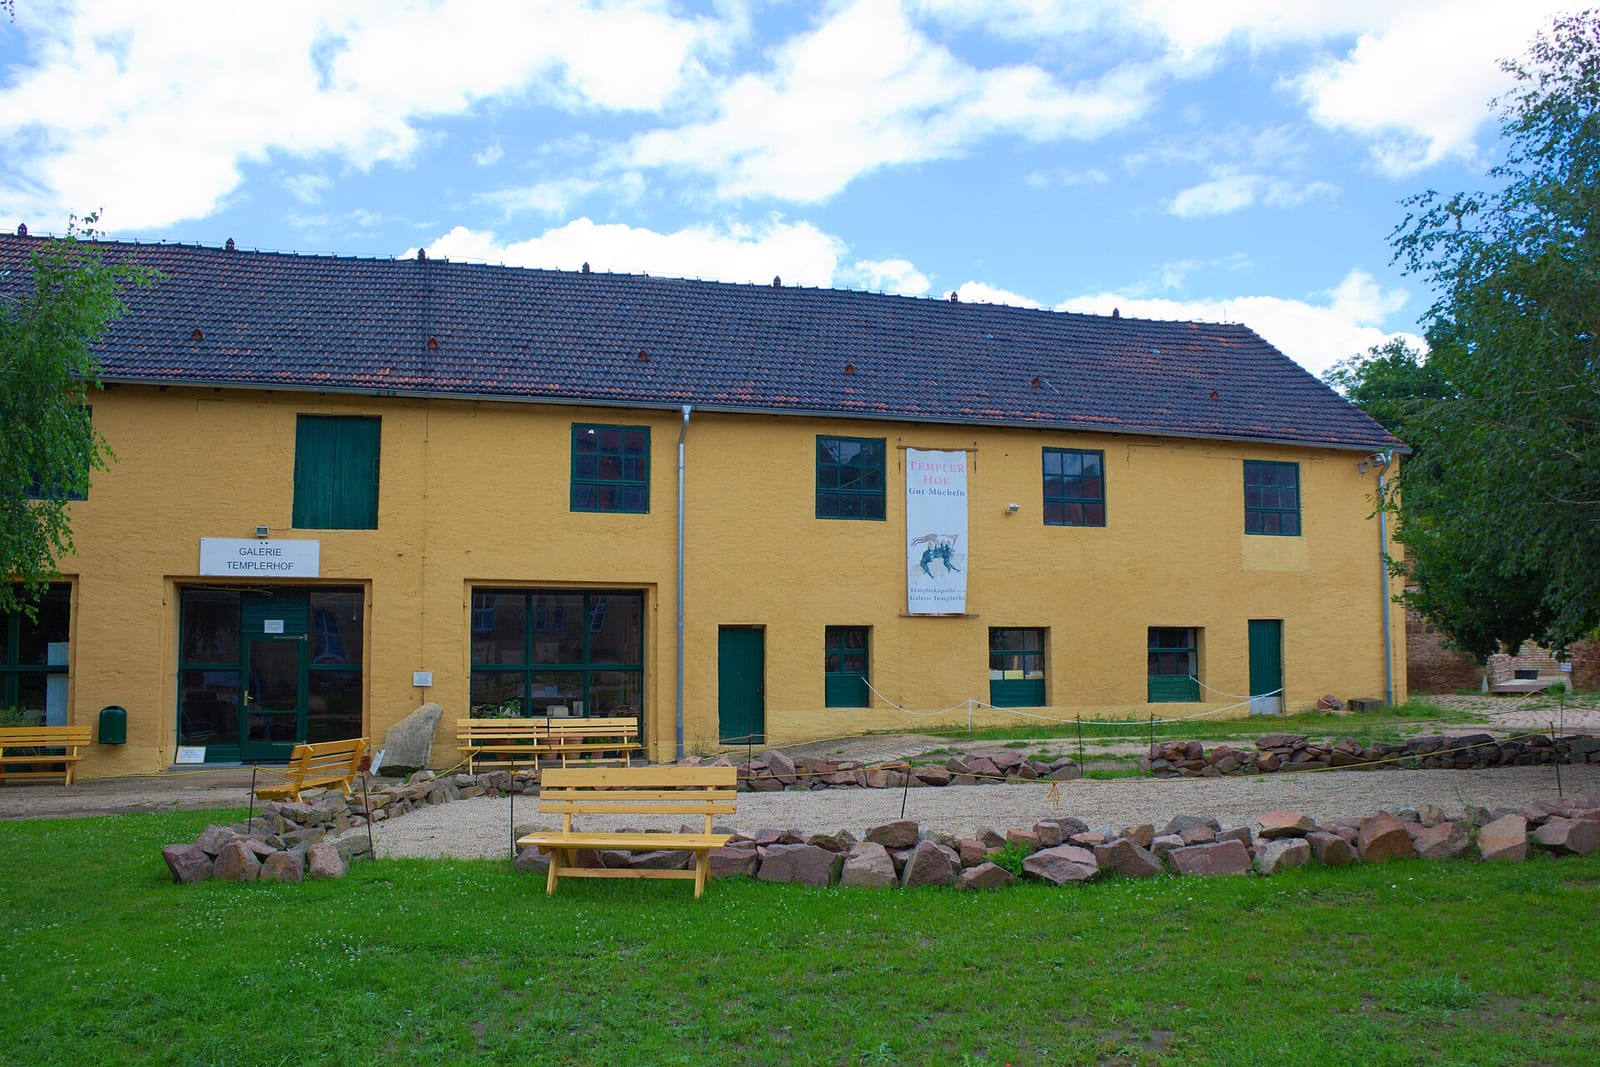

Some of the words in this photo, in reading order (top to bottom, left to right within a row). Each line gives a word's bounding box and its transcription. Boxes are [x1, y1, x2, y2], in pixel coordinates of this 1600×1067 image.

[909, 460, 965, 473] TEMPLER
[923, 474, 952, 486] HOF
[908, 487, 925, 495] Gut
[238, 547, 282, 556] GALERIE
[226, 561, 294, 570] TEMPLERHOF
